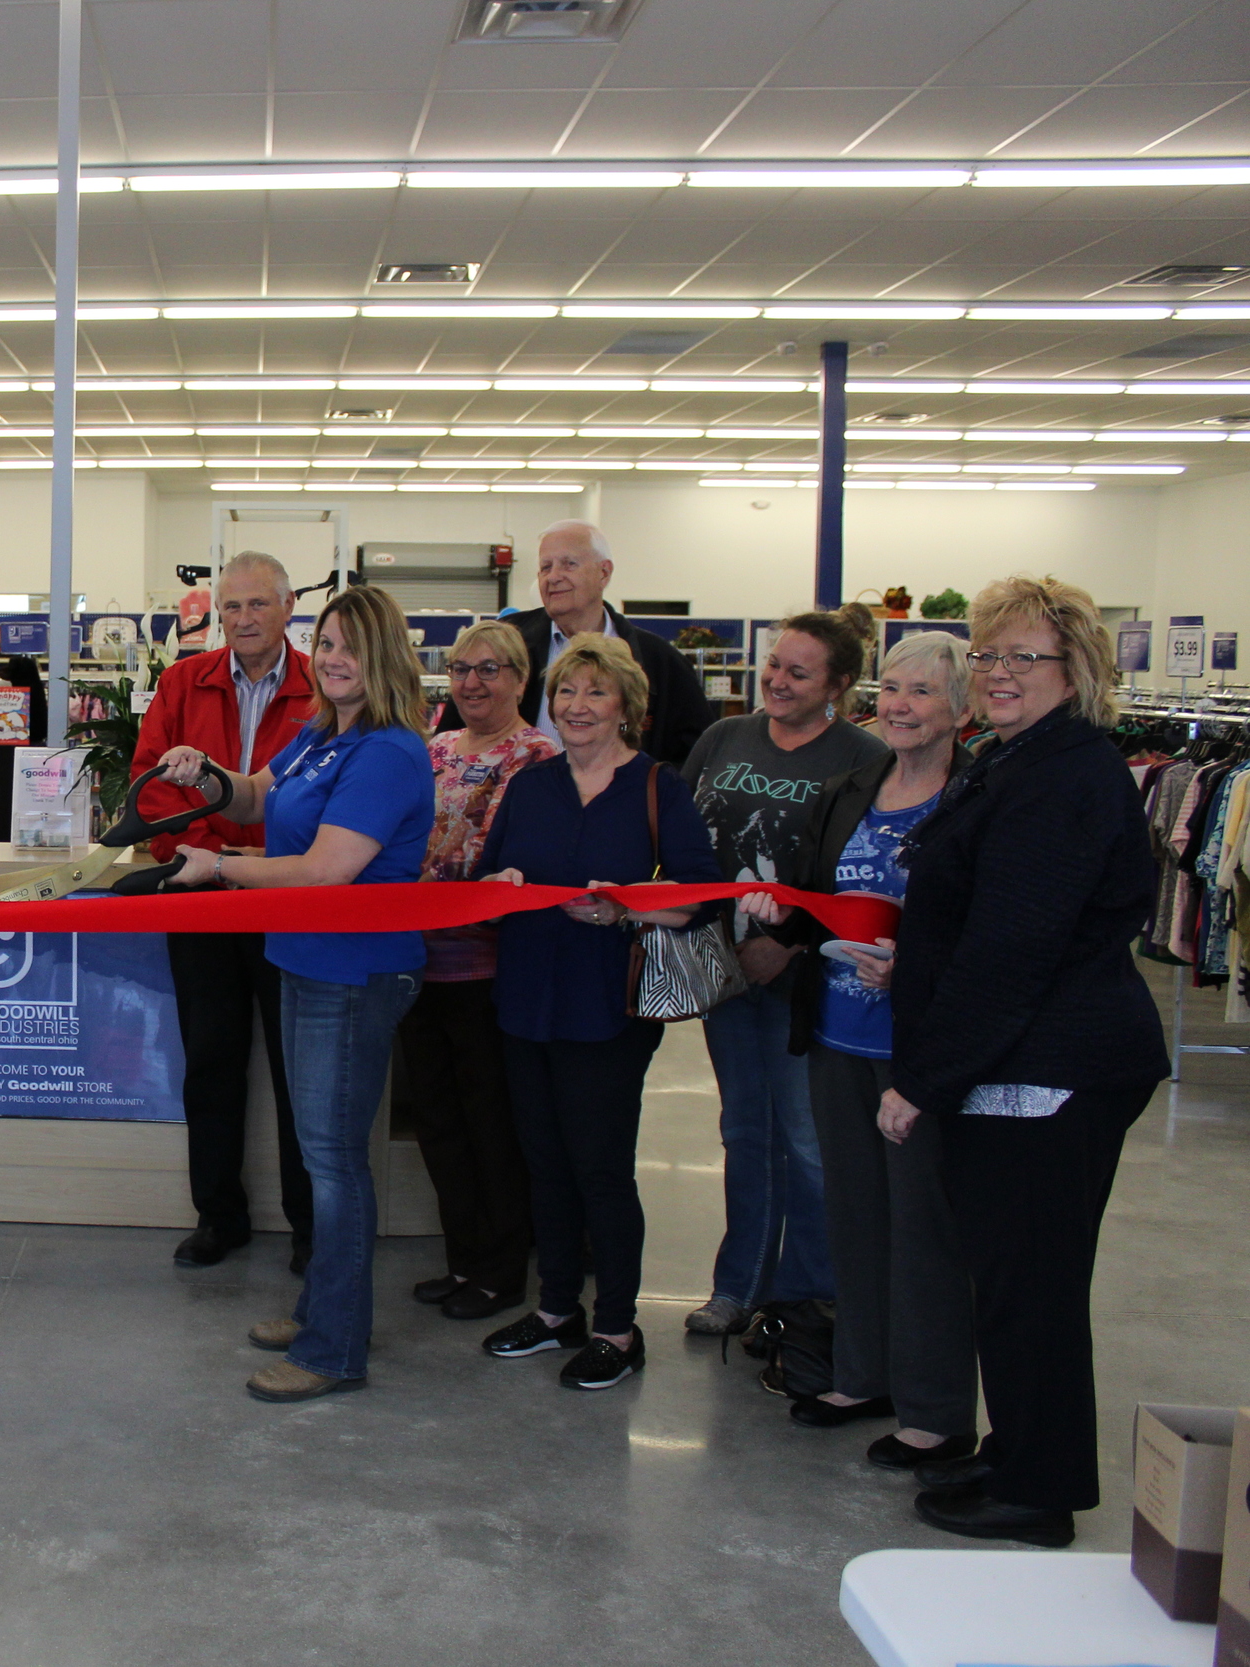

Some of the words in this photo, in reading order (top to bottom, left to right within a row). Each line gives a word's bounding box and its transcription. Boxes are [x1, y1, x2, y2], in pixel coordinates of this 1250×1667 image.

[1173, 641, 1198, 657] $3.99
[25, 769, 67, 778] goodwill
[24, 1036, 56, 1044] central
[58, 1036, 78, 1045] ohio
[32, 1065, 47, 1075] TO
[51, 1065, 85, 1076] YOUR
[8, 1080, 74, 1092] Goodwill
[76, 1082, 113, 1093] STORE
[63, 1096, 78, 1104] FOR
